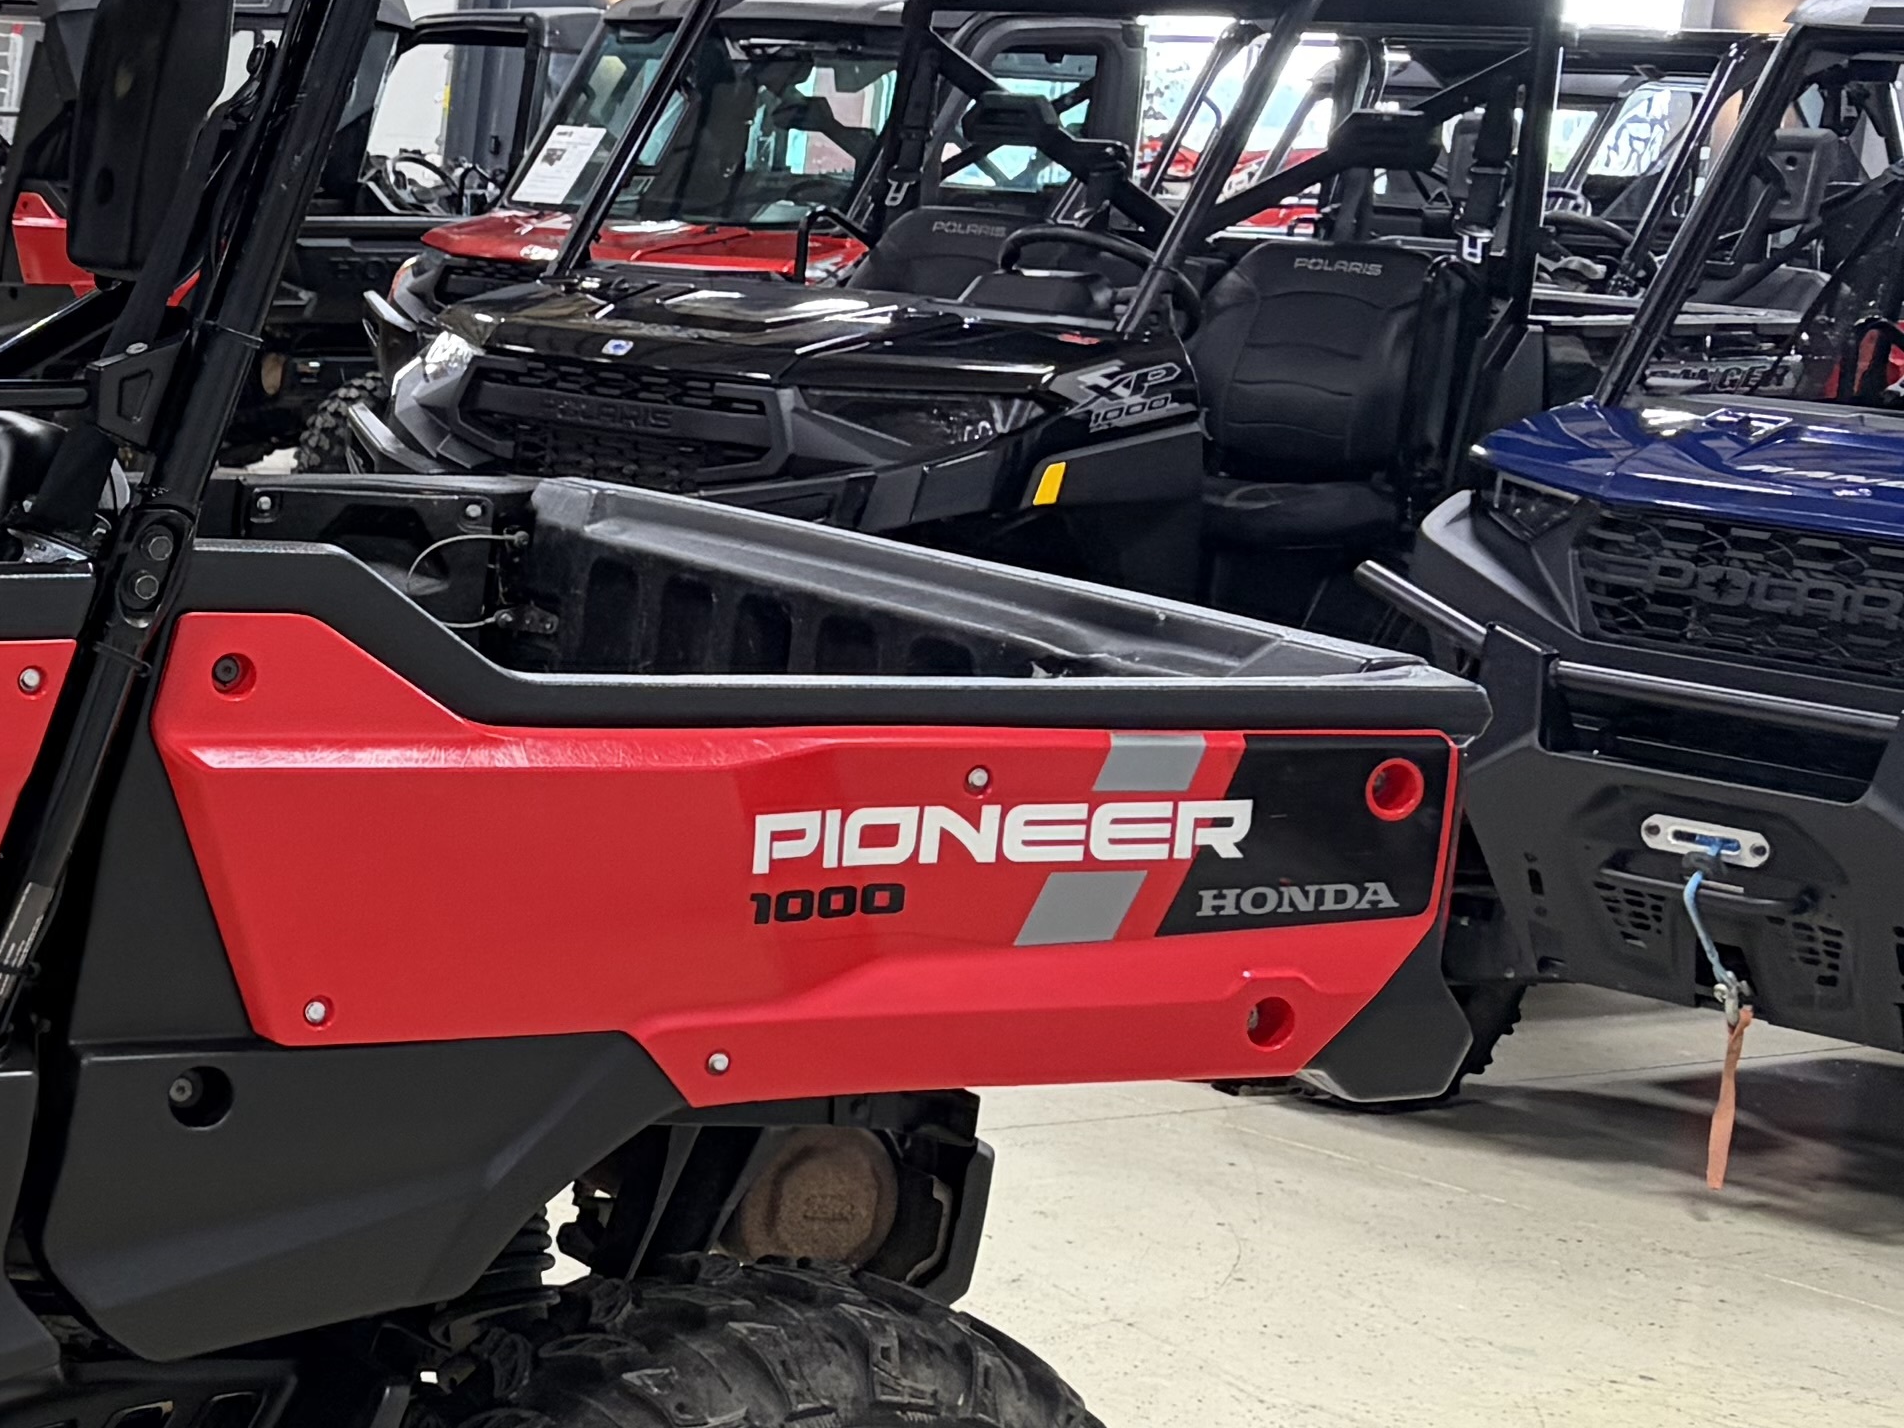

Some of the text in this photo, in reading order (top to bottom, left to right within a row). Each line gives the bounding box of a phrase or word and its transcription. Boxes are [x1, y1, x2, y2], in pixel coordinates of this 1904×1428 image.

[932, 221, 1006, 237] POLARIS
[1294, 258, 1383, 276] POLARIS
[1064, 362, 1181, 415] XP
[1090, 393, 1171, 428] 1000
[752, 799, 1254, 874] PIONEER
[750, 883, 906, 924] 1000
[1196, 881, 1399, 917] HONDA
